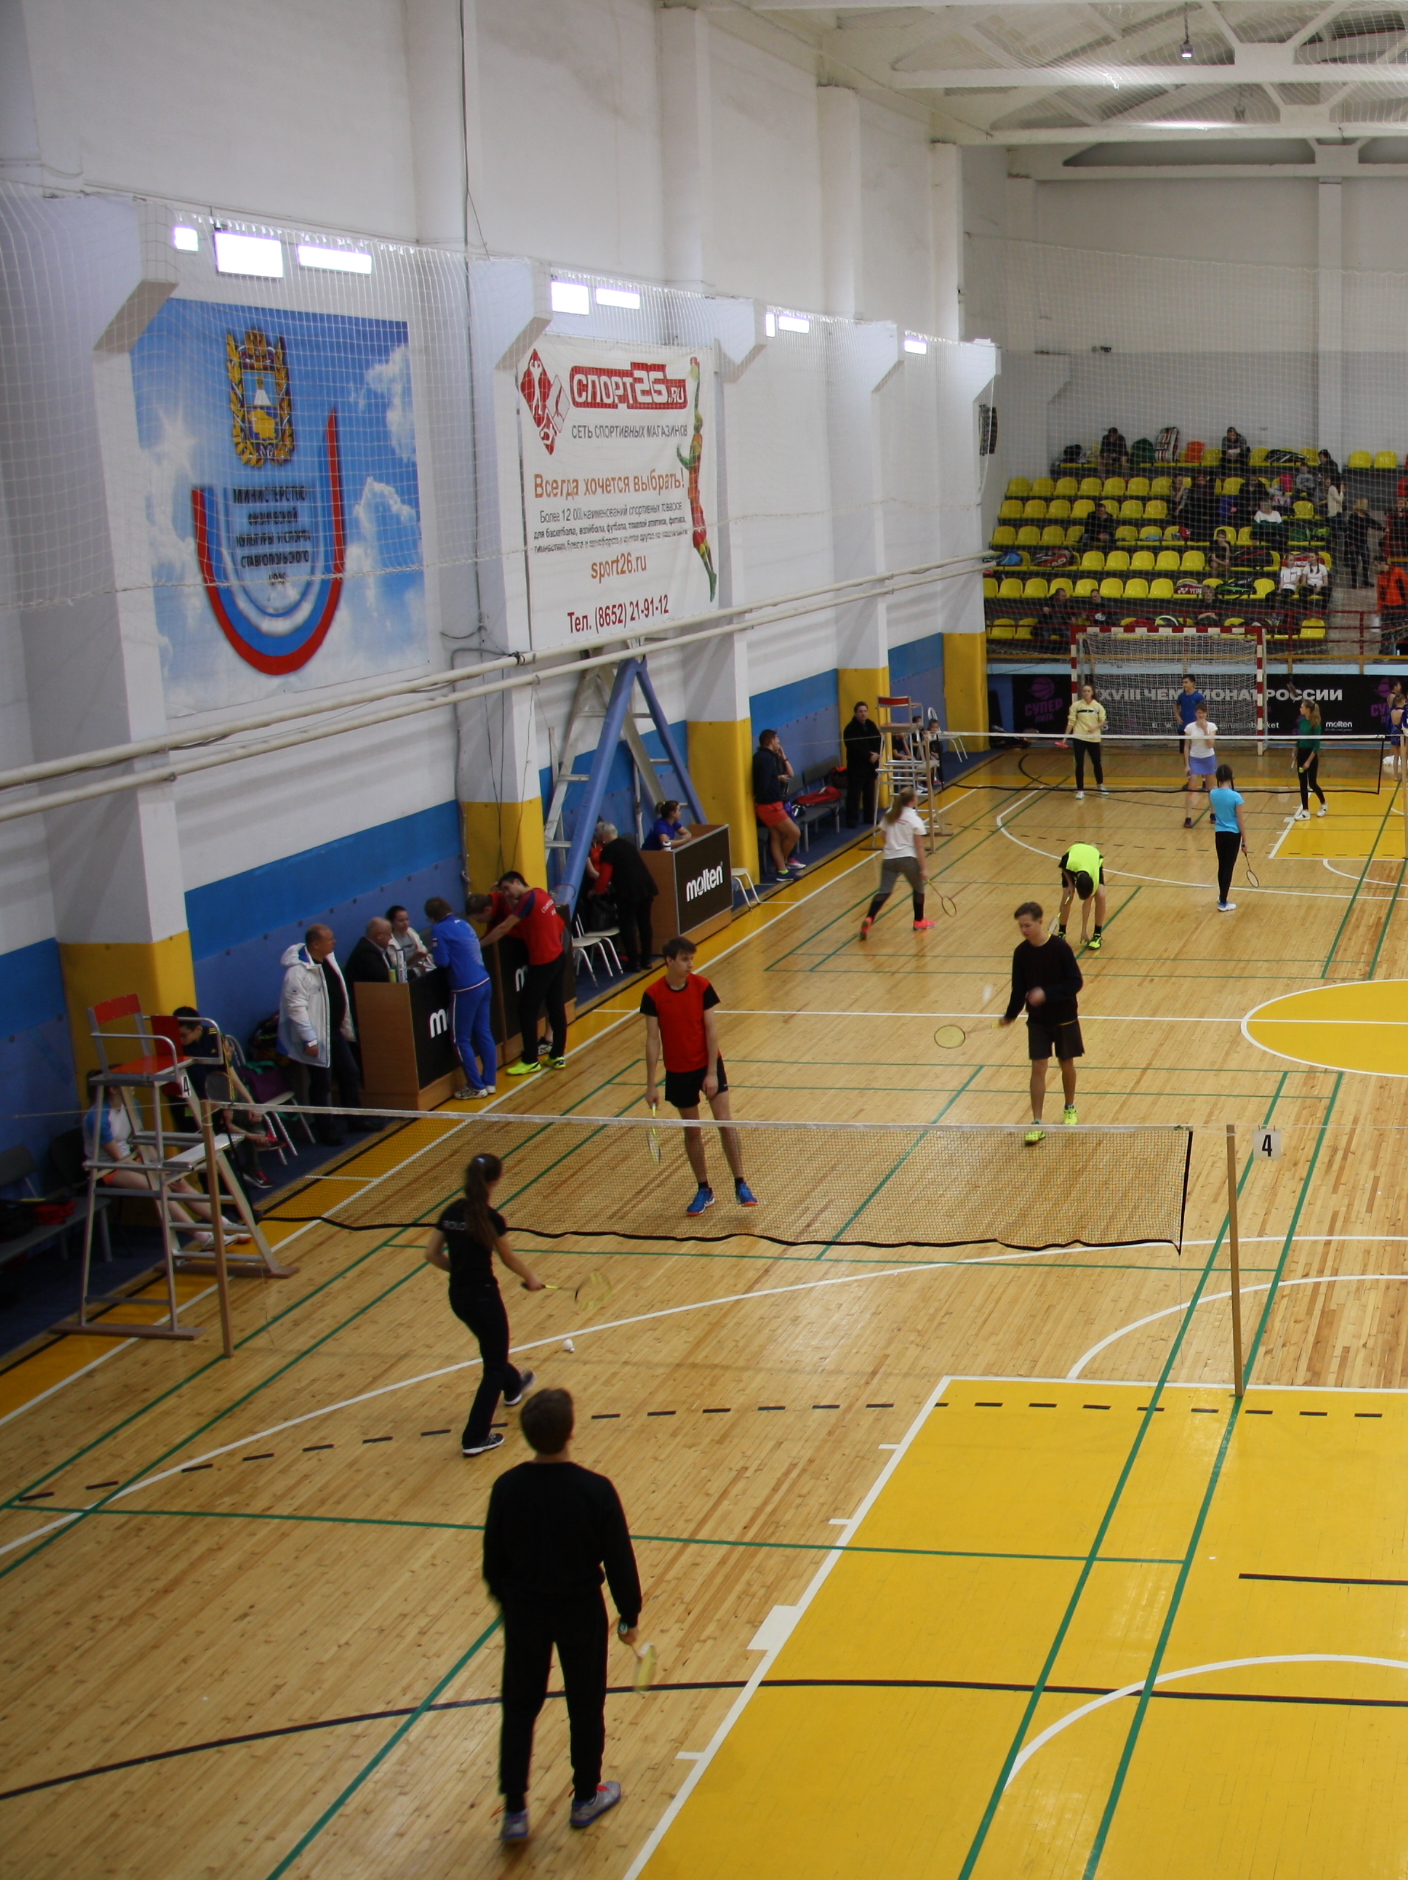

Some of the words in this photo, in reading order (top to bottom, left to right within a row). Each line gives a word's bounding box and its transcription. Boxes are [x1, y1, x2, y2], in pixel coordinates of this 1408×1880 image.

[571, 424, 593, 440] СЕТЬ
[594, 424, 645, 439] СПОРТИВНЫХ
[646, 424, 688, 438] МАГАЗИНОВ
[533, 473, 580, 500] Всегда
[583, 476, 630, 496] хочется
[633, 467, 685, 496] выбрать!
[233, 486, 307, 504] МИНИСТЕРСТВО
[248, 507, 298, 526] ФИЗИЧЕСКОЙ
[540, 510, 560, 524] Более
[562, 508, 570, 522] 12
[583, 504, 628, 520] наименований
[628, 503, 660, 517] спортивных
[236, 532, 274, 548] КУЛЬТУРЫ
[284, 530, 312, 544] СПОРТА
[533, 530, 544, 542] для
[546, 526, 578, 538] баскетбола,
[241, 550, 310, 568] СТАВРОПОЛЬСКОГО
[591, 552, 647, 584] sport26.ru
[567, 611, 592, 634] Тел.
[594, 602, 627, 634] (8652)
[630, 594, 670, 622] 21-91-12
[1266, 689, 1343, 702] РОССИИ
[1024, 698, 1063, 716] СУПЕР
[686, 865, 723, 902] molten
[184, 1076, 190, 1096] 4
[1262, 1134, 1273, 1157] 4
